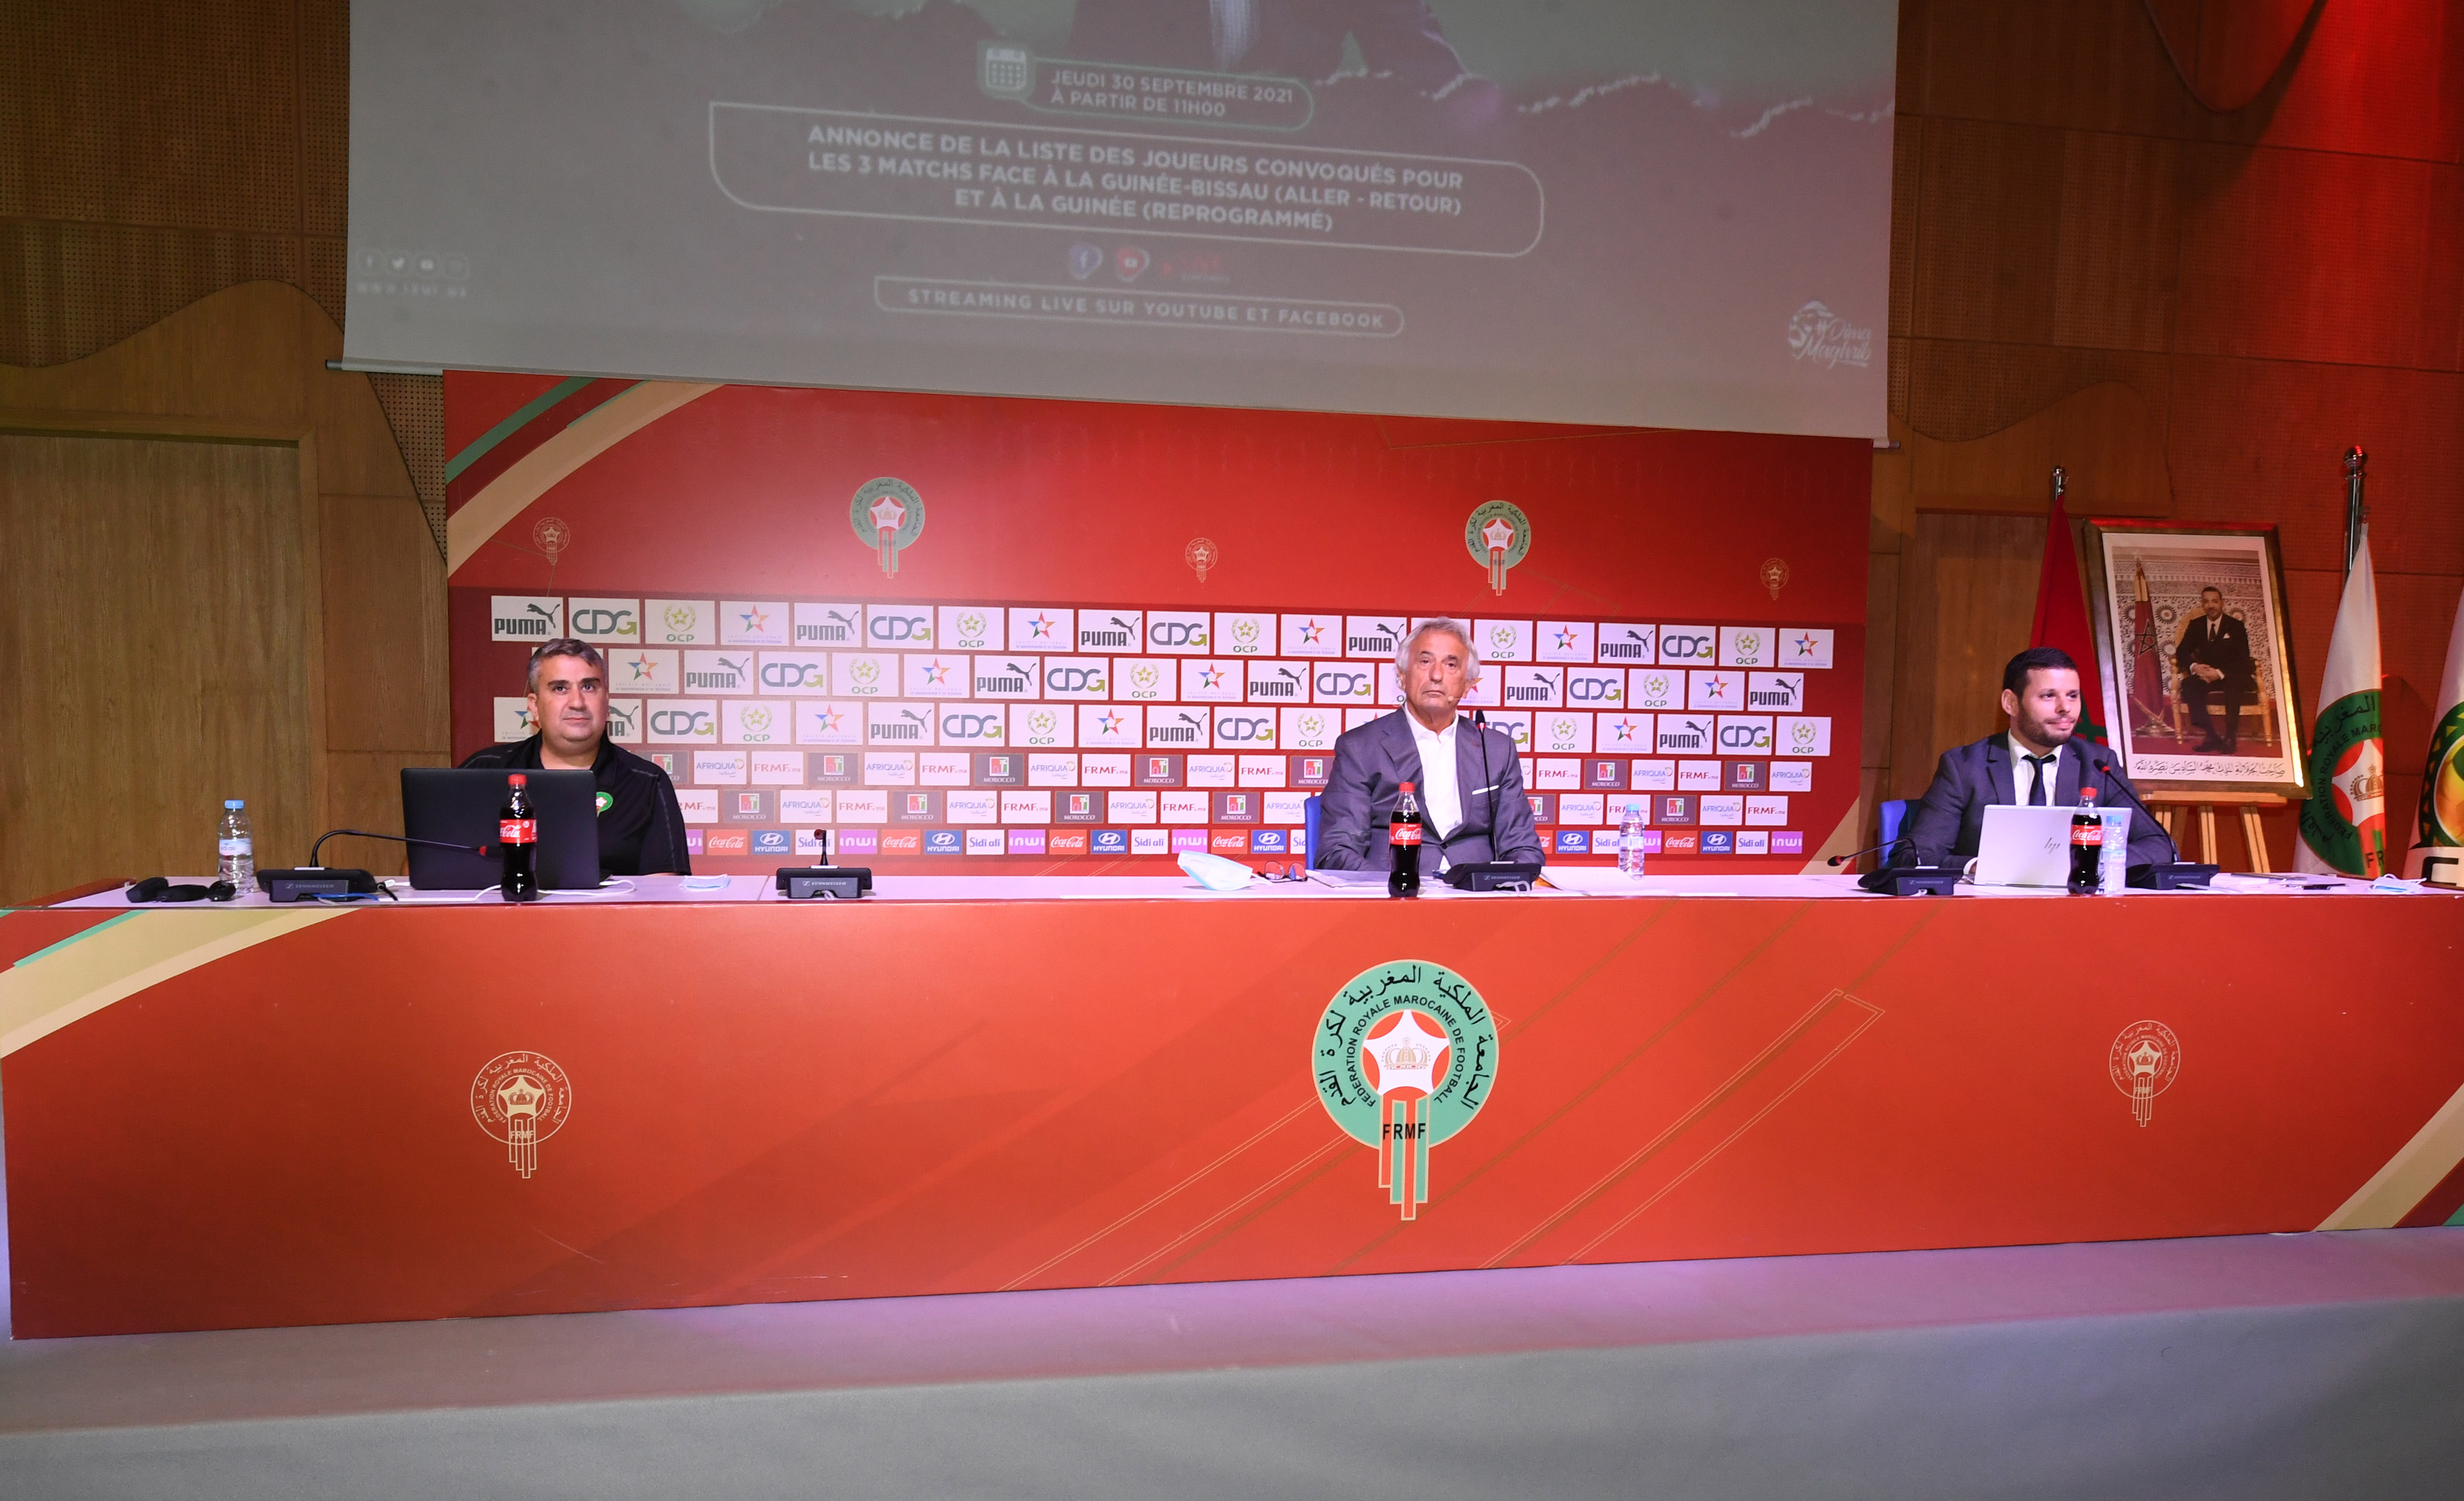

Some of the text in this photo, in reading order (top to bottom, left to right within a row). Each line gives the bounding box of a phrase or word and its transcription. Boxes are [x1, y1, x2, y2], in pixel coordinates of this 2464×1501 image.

[1051, 70, 1294, 103] JEUDI 30 SEPTEMBRE 2021
[1050, 84, 1226, 116] À PARTIR DE 11H00
[808, 124, 1463, 189] ANNONCE DE LA LISTE DES JOUEURS CONVOQUÉS POUR
[808, 151, 851, 172] LES
[859, 155, 871, 173] 3
[878, 157, 973, 180] MATCHS
[979, 163, 1036, 184] FACE
[1043, 164, 1059, 186] À
[1065, 169, 1093, 189] LA
[1102, 171, 1268, 201] GUINÉE-BISSAU
[1275, 185, 1349, 207] (ALLER
[1369, 190, 1462, 216] RETOUR)
[955, 185, 1333, 232] ET À LA GUINÉE (REPROGRAMMÉ)
[908, 288, 1383, 328] STREAMING LIVE SUR YOUTUBE ET FACEBOOK
[495, 618, 546, 635] PUMA
[572, 610, 636, 635] CDG
[797, 625, 845, 640] PUMA
[870, 616, 930, 640] CDG
[1081, 631, 1126, 646] PUMA
[1150, 623, 1207, 646] CDG
[1349, 636, 1395, 651] PUMA
[1601, 644, 1641, 658] PUMA
[1662, 636, 1713, 658] CDG
[686, 672, 735, 688] PUMA
[761, 663, 823, 687] CDG
[977, 677, 1023, 692] PUMA
[1047, 668, 1105, 692] CDG
[1316, 673, 1371, 696] CDG
[1250, 682, 1294, 696] PUMA
[1507, 687, 1548, 701] PUMA
[1569, 678, 1621, 701] CDG
[1750, 692, 1789, 705] PUMA
[650, 711, 713, 735] CDG
[871, 724, 918, 739] PUMA
[942, 714, 1002, 738] CDG
[1218, 718, 1273, 741] CDG
[1150, 727, 1194, 742] PUMA
[1660, 734, 1699, 748] PUMA
[1720, 726, 1770, 747] CDG
[2320, 735, 2350, 775] ROYALE
[1111, 801, 1146, 810] AFRIQUIA
[2318, 778, 2353, 839] FEDERATION
[970, 837, 1000, 847] Sidi ali
[1134, 836, 1164, 846] Sidi ali
[1595, 837, 1611, 846] Sidi
[1738, 837, 1754, 846] Sidi
[1319, 965, 1493, 1109] الجامعة الملكية المغربية لكرة القدم
[1346, 995, 1466, 1107] FEDERATION ROYALE MAROCAINE DE FOOTBALL
[489, 1069, 553, 1124] FEDERATION ROYALE MAROCAINE DE FOOTBALL
[511, 1130, 534, 1139] FRMF
[1383, 1123, 1426, 1139] FRMF
